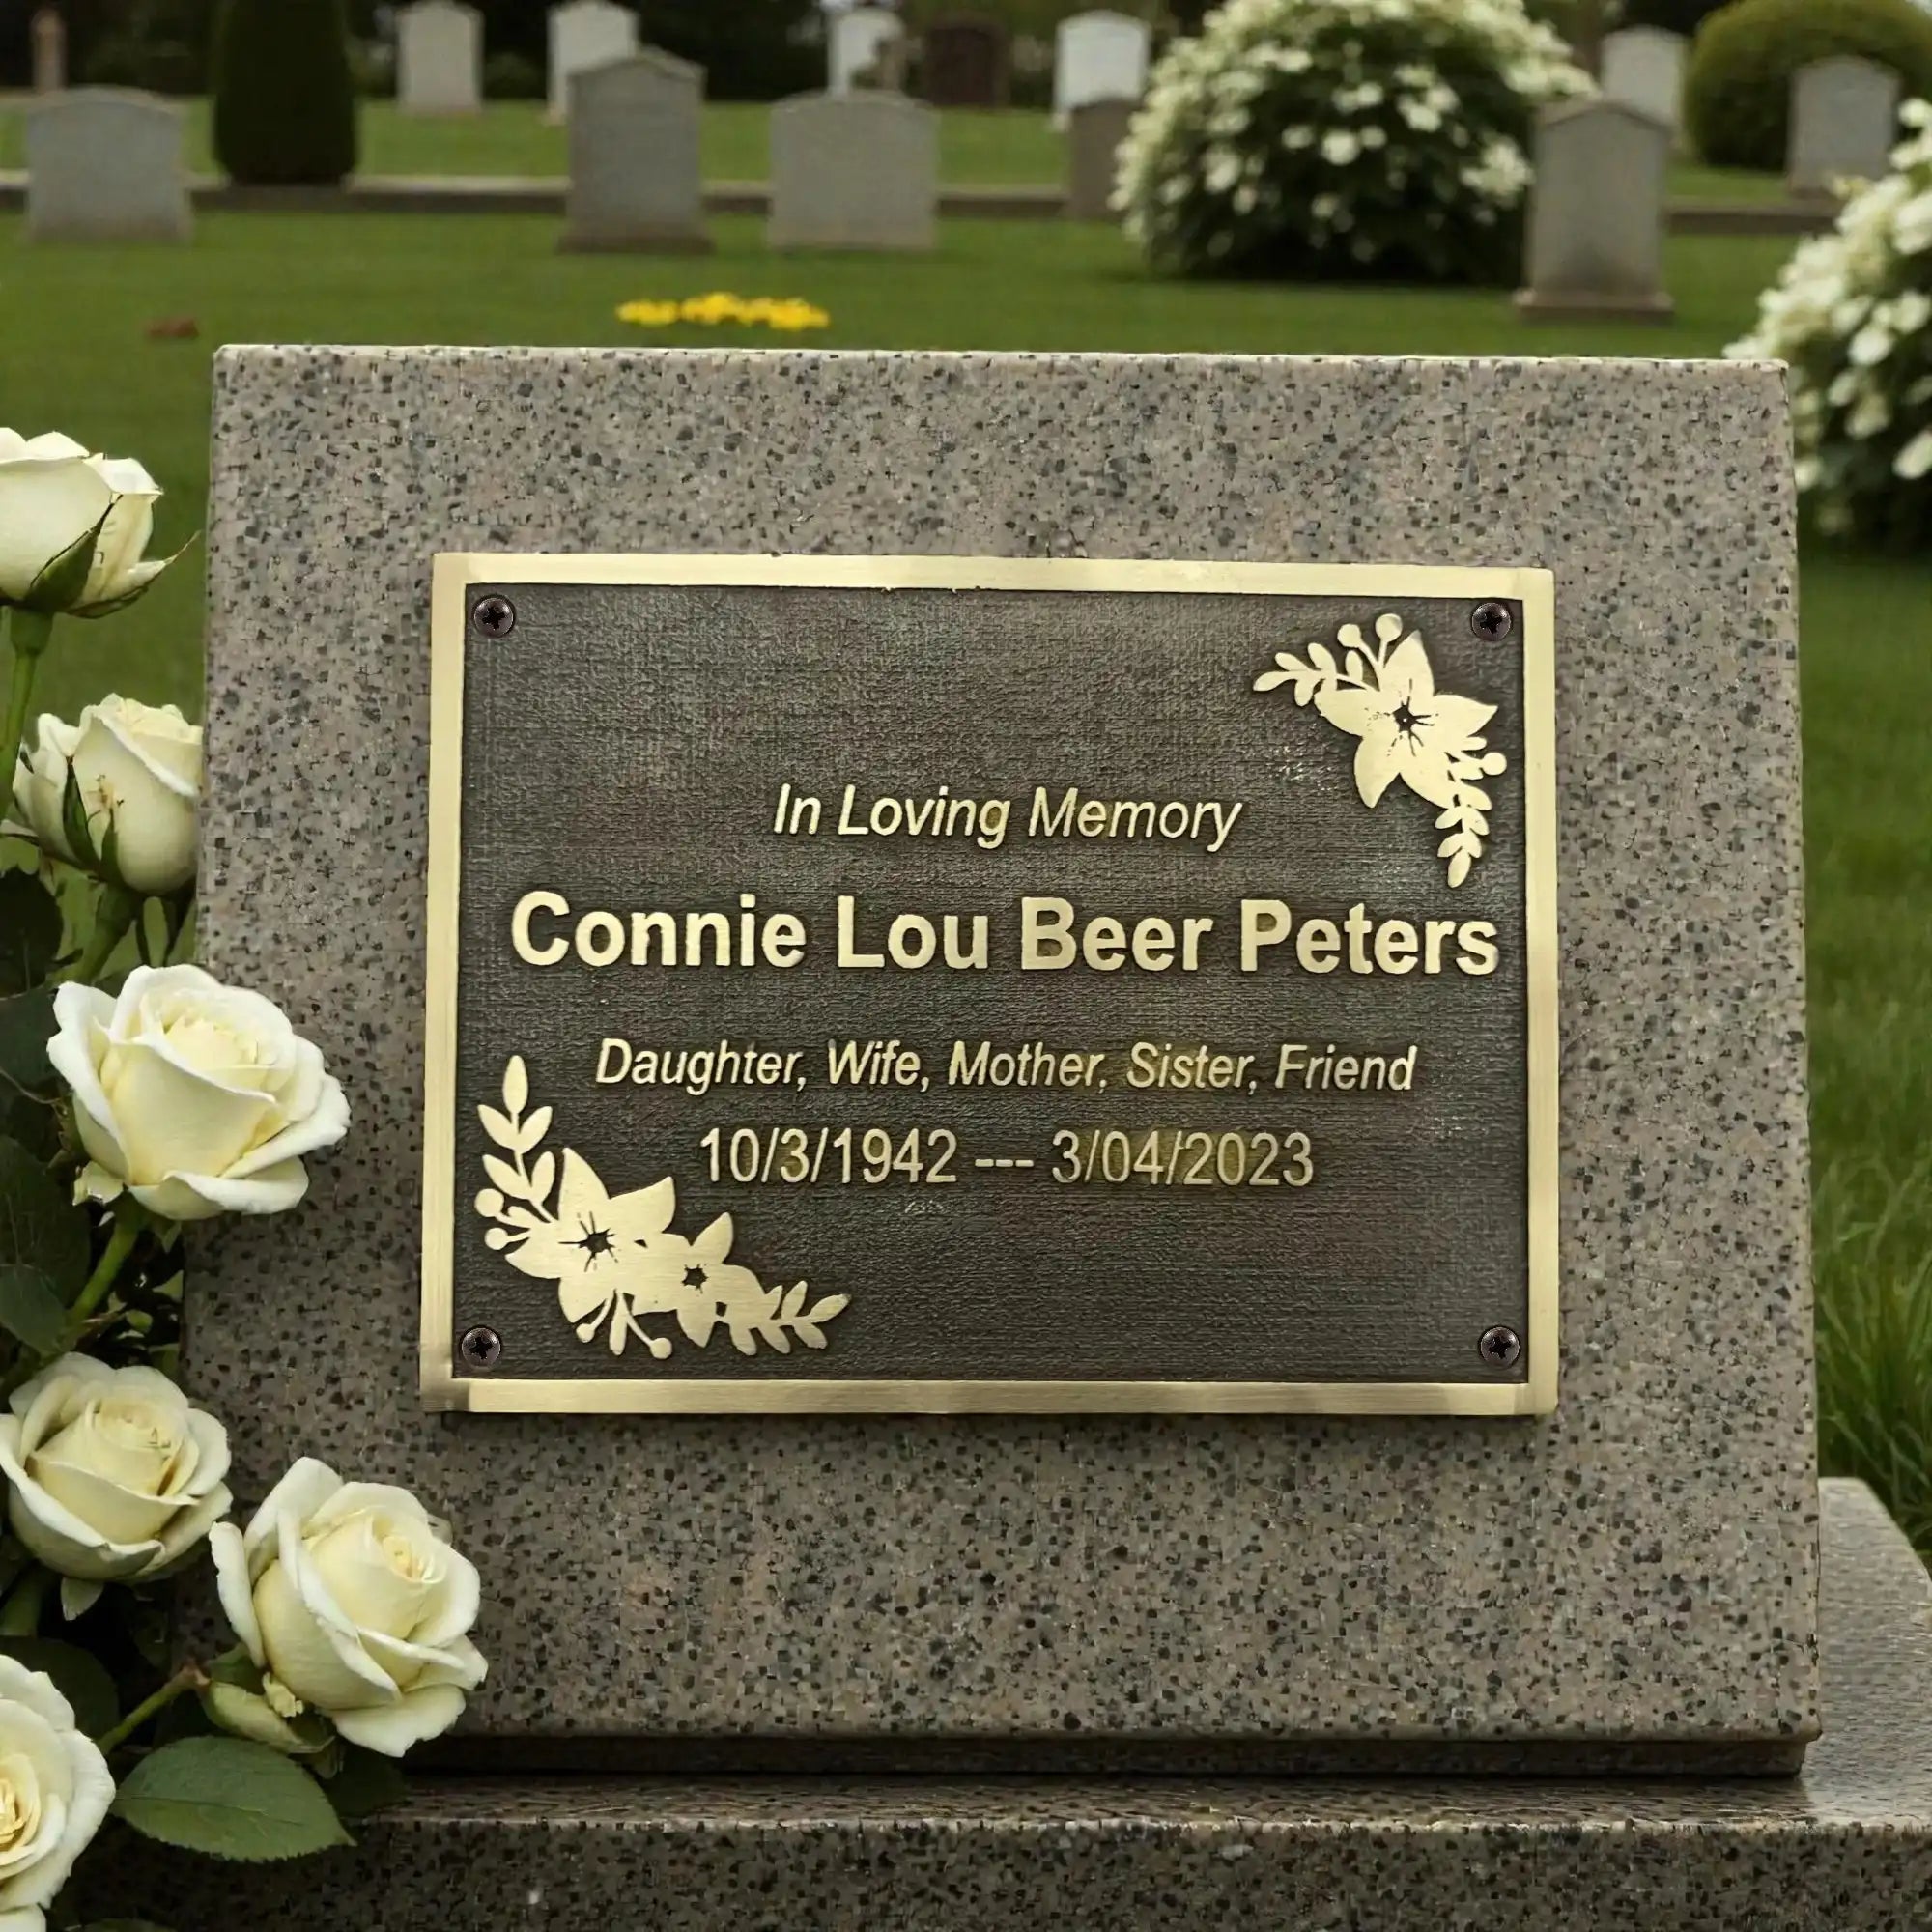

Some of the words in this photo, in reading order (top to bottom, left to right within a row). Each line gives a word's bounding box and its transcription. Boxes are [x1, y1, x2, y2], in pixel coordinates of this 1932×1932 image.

[774, 783, 822, 835] In
[838, 784, 1011, 849] Loving
[1028, 786, 1243, 852] Memory
[511, 890, 807, 967] Connie
[837, 895, 989, 969] Lou
[1020, 896, 1214, 972] Beer
[1240, 899, 1499, 975] Peters
[595, 1037, 807, 1095] Daughter,
[828, 1039, 929, 1093] Wife,
[948, 1040, 1107, 1094] Mother,
[1126, 1041, 1257, 1095] Sister,
[1274, 1044, 1418, 1092] Friend
[699, 1127, 957, 1184] 10/3/1942
[1051, 1129, 1315, 1187] 3/04/2023
